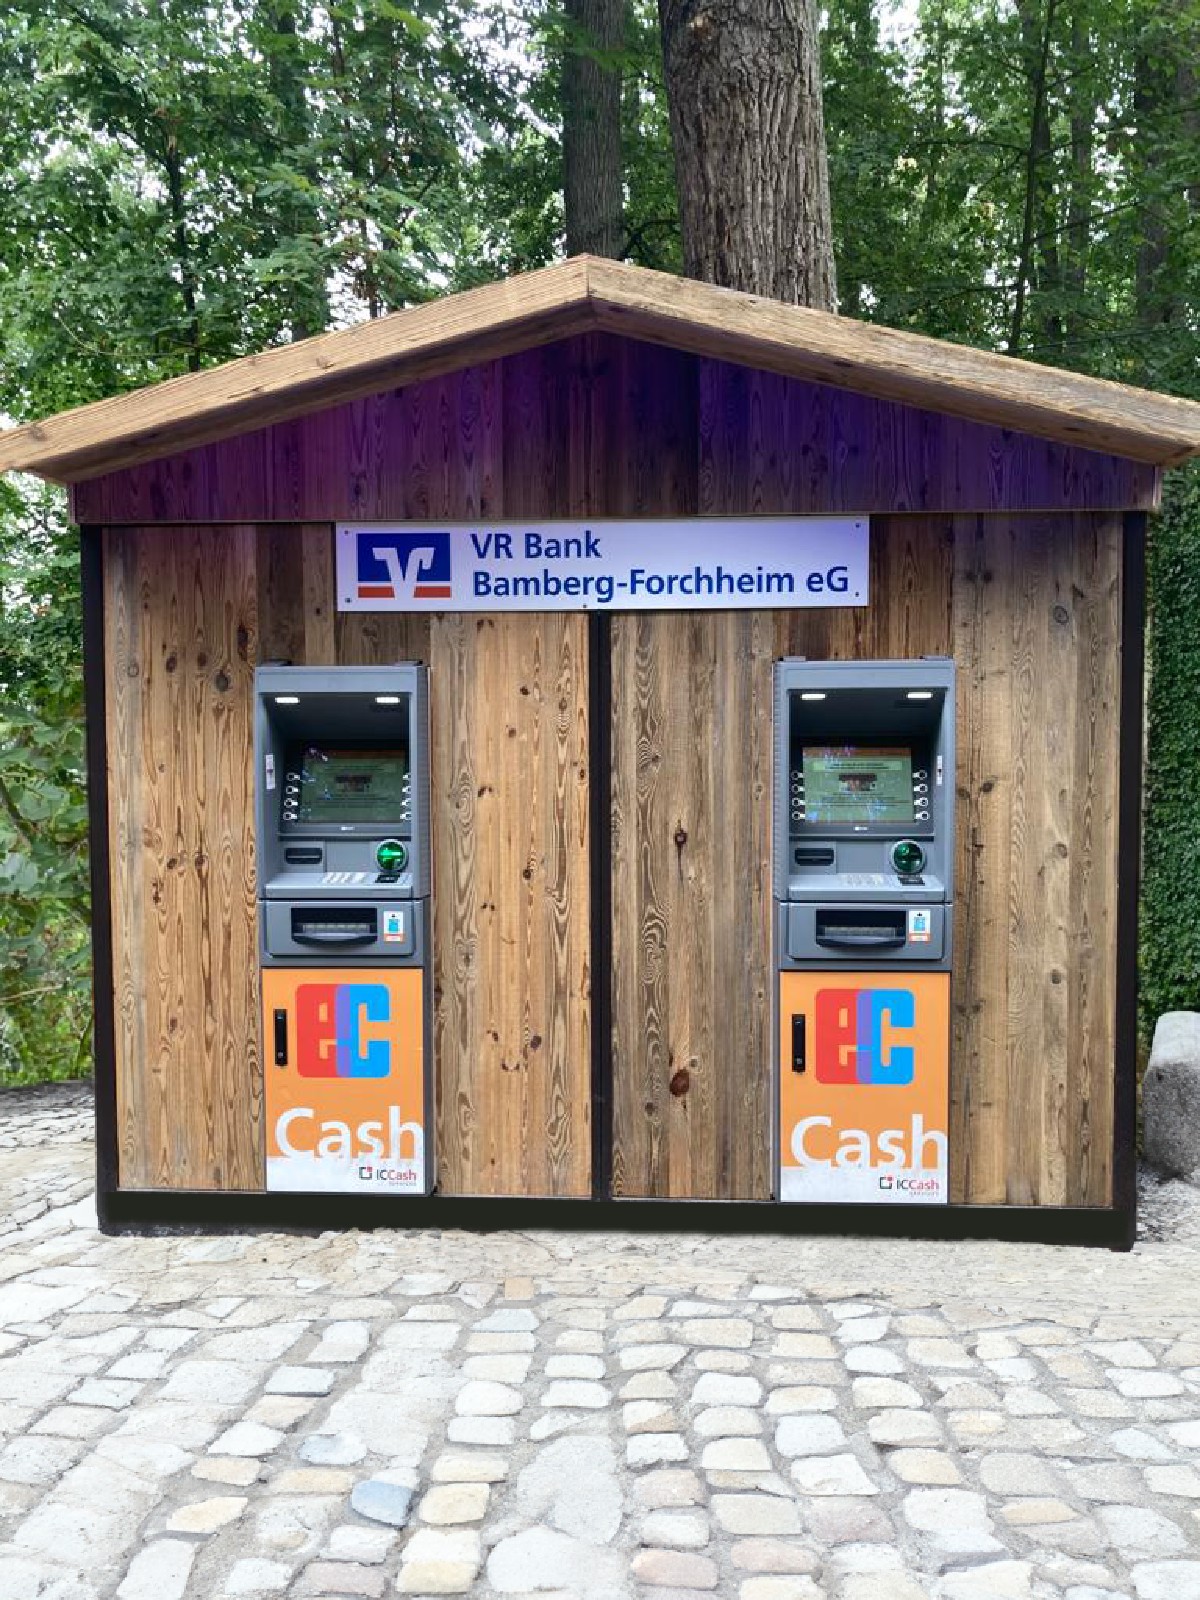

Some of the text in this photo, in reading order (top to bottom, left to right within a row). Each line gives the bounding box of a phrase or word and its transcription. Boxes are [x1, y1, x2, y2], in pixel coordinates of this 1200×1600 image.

[471, 530, 602, 560] VR Bank
[473, 566, 850, 603] Bamberg-Forchheim eG
[275, 1105, 424, 1160] Cash
[791, 1113, 948, 1170] Cash
